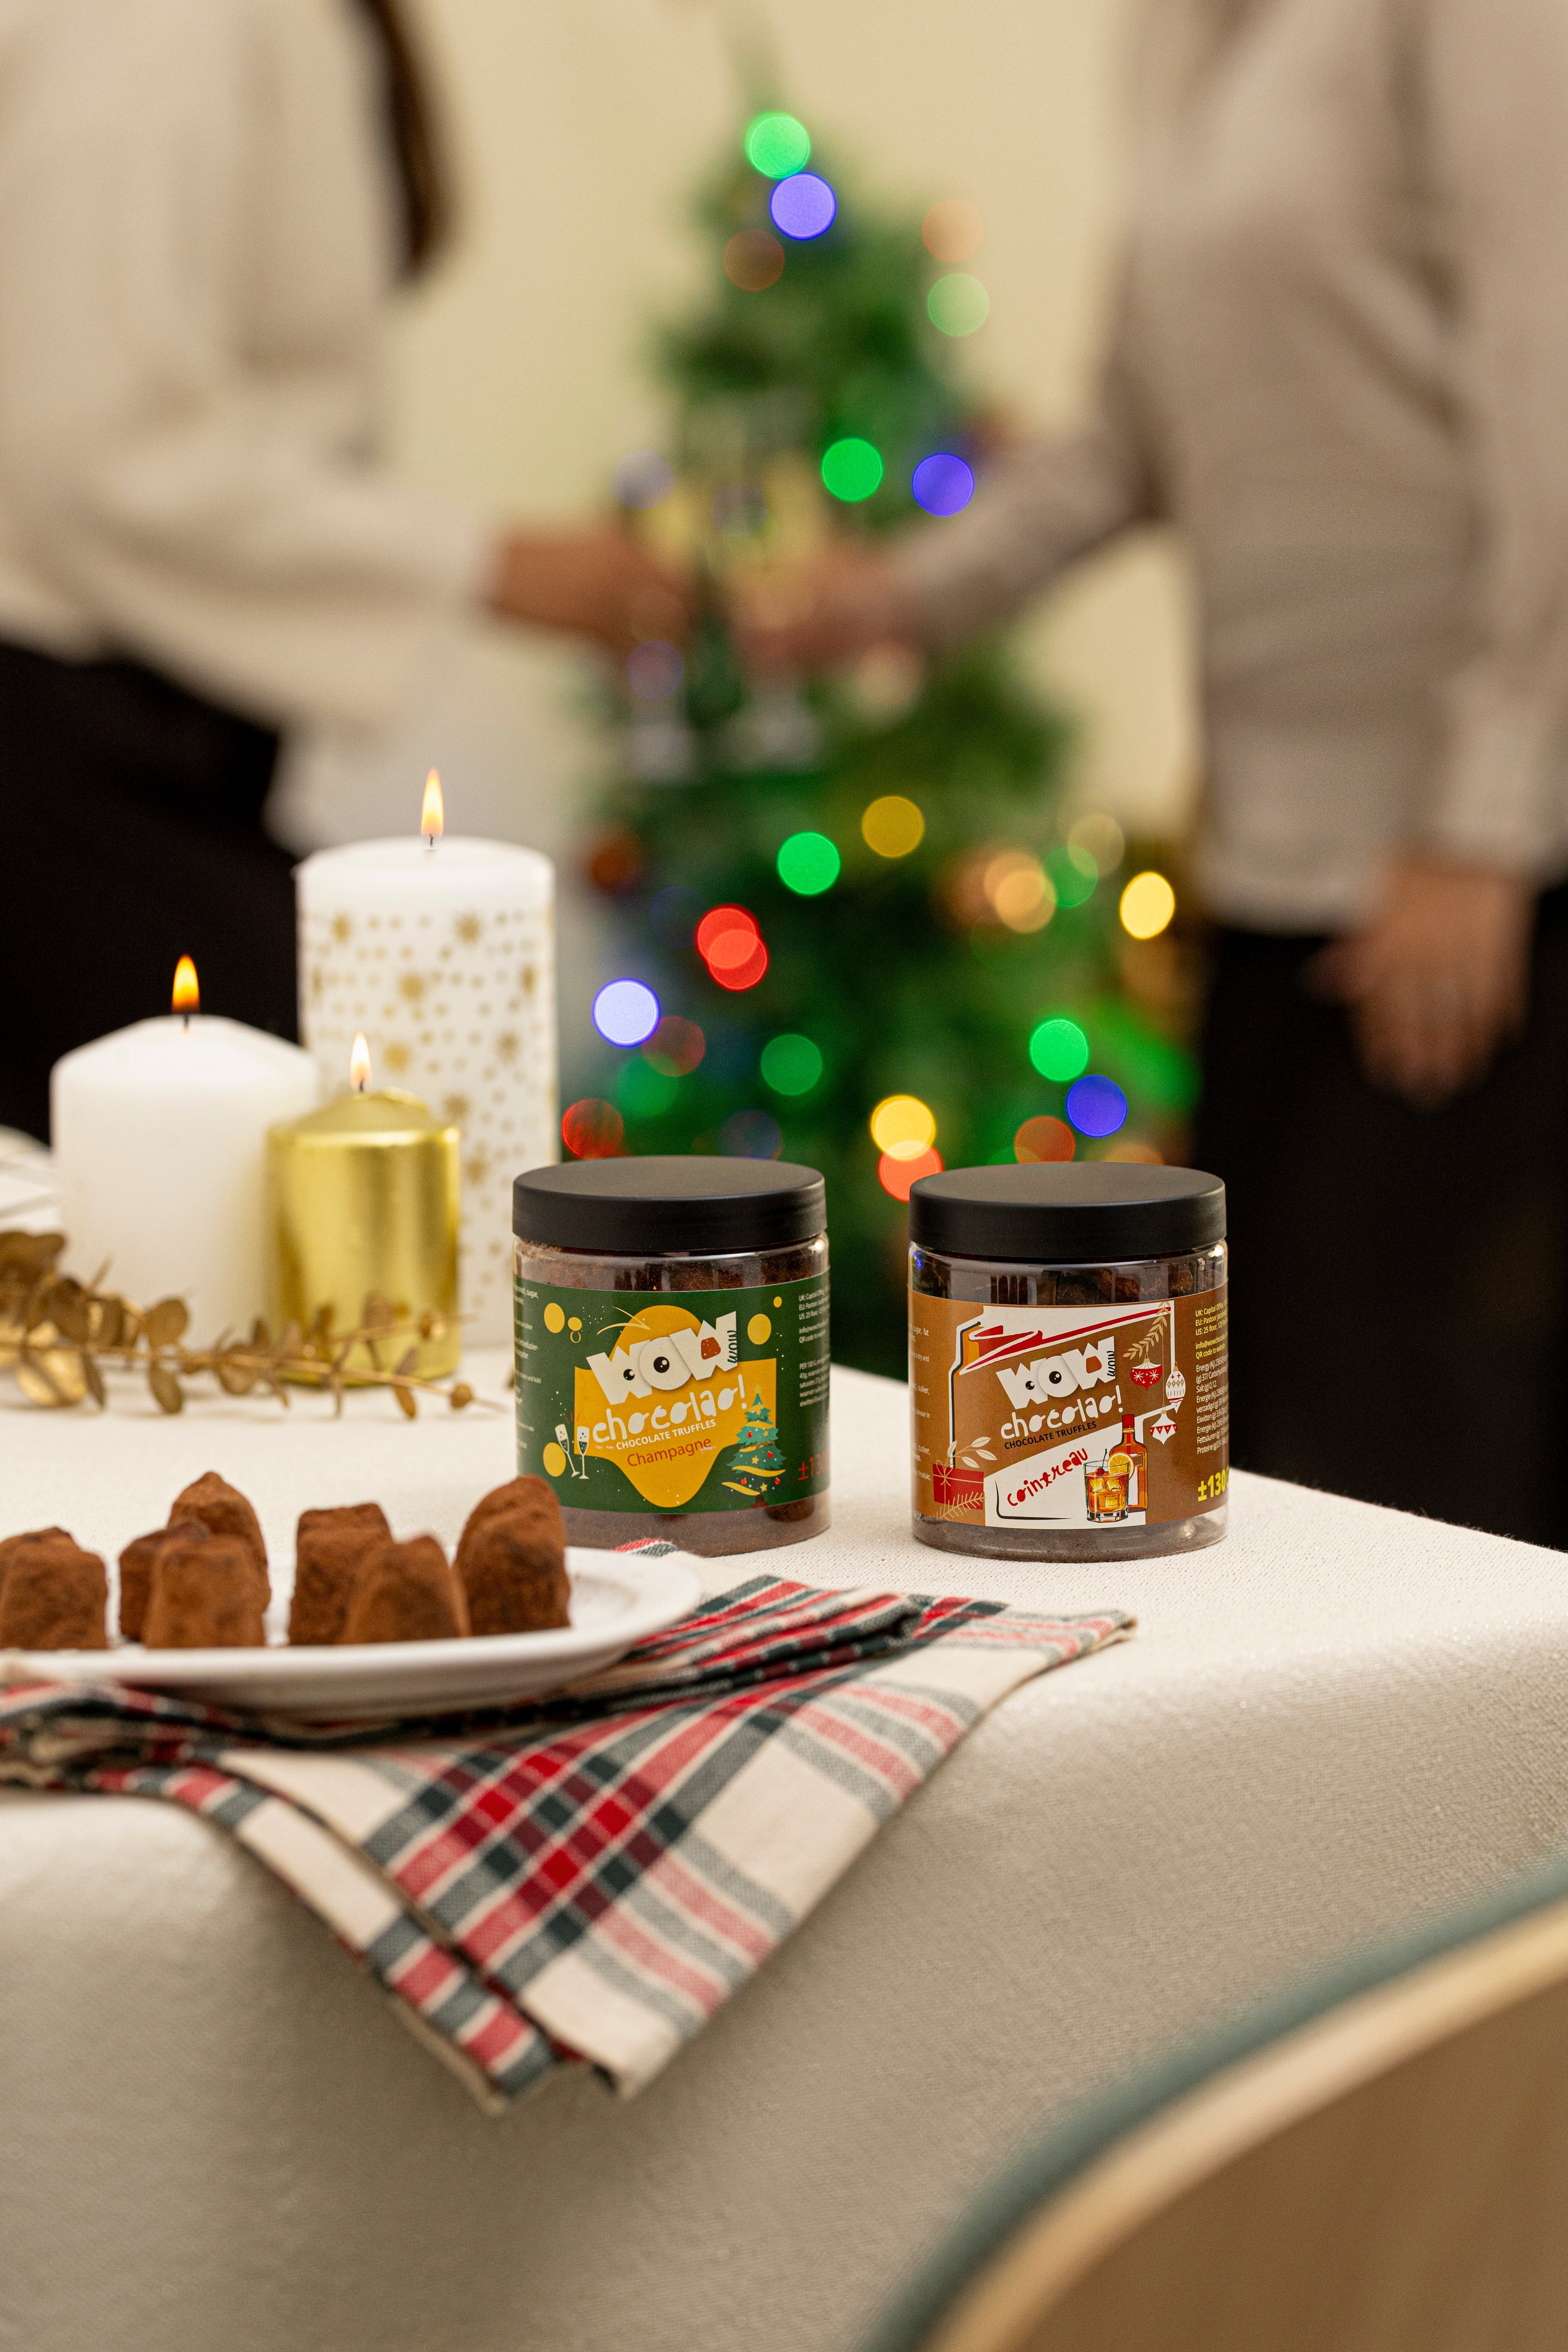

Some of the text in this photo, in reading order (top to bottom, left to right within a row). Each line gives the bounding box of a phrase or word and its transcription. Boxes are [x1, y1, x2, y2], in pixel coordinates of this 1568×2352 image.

[1203, 1305, 1216, 1316] Capital
[1203, 1314, 1217, 1324] Pastoor
[586, 1311, 738, 1405] WOW
[1196, 1351, 1203, 1360] QR
[1203, 1348, 1212, 1357] code
[996, 1336, 1116, 1410] WOW
[1196, 1363, 1210, 1372] Energy
[1196, 1384, 1204, 1393] Salt
[1196, 1393, 1211, 1403] Energie
[592, 1374, 747, 1443] chocolao!
[1000, 1385, 1123, 1440] chocolao!
[616, 1419, 716, 1450] CHOCOLATE TRUFFLES
[1004, 1421, 1097, 1450] CHOCOLATE TRUFFLES
[1197, 1423, 1212, 1434] Energie
[627, 1438, 711, 1466] Champagne
